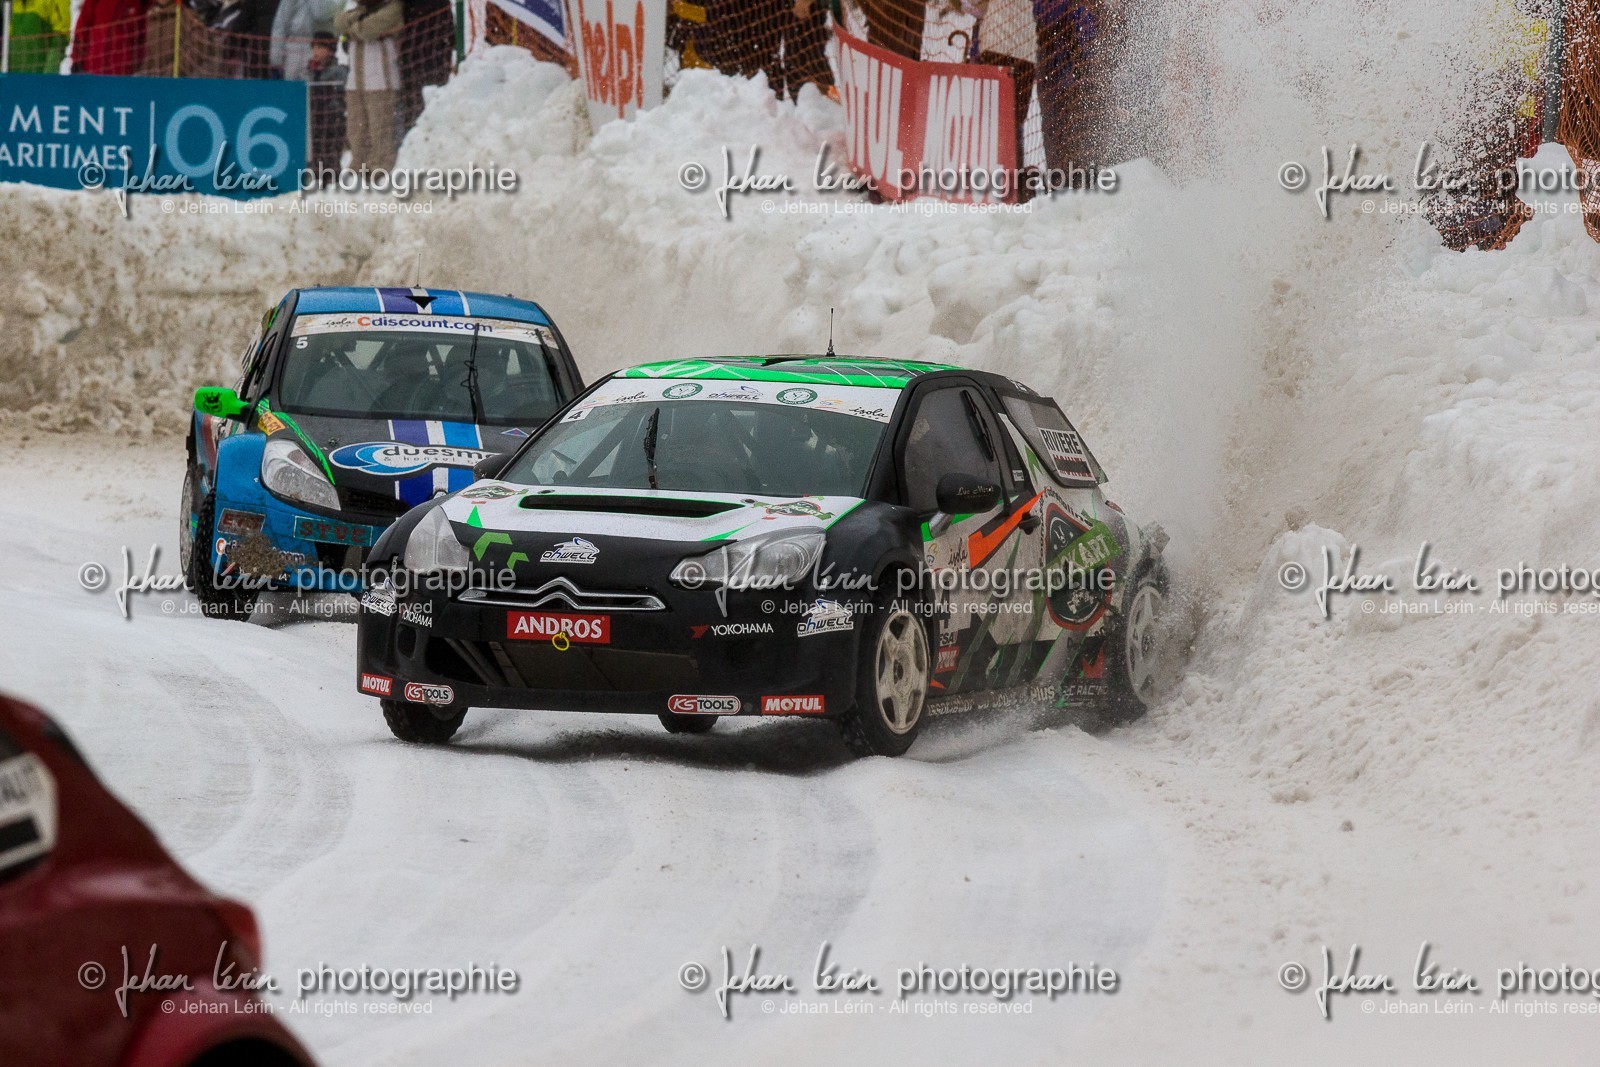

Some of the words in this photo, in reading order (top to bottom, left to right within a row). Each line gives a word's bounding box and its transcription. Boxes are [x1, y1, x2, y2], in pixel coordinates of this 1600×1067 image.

[9, 104, 134, 136] MENT
[165, 104, 290, 179] 06
[357, 316, 493, 333] Cdiscount.com
[296, 337, 308, 349] 5
[568, 410, 583, 420] 4
[849, 407, 888, 419] isola
[1040, 429, 1083, 455] RIVIERE
[514, 616, 603, 639] ANDROS
[711, 623, 774, 636] YOKOHAMA
[362, 675, 390, 693] MOTUL
[423, 688, 449, 700] TOOLS
[698, 699, 735, 710] TOOLS
[764, 697, 822, 711] MOTUL
